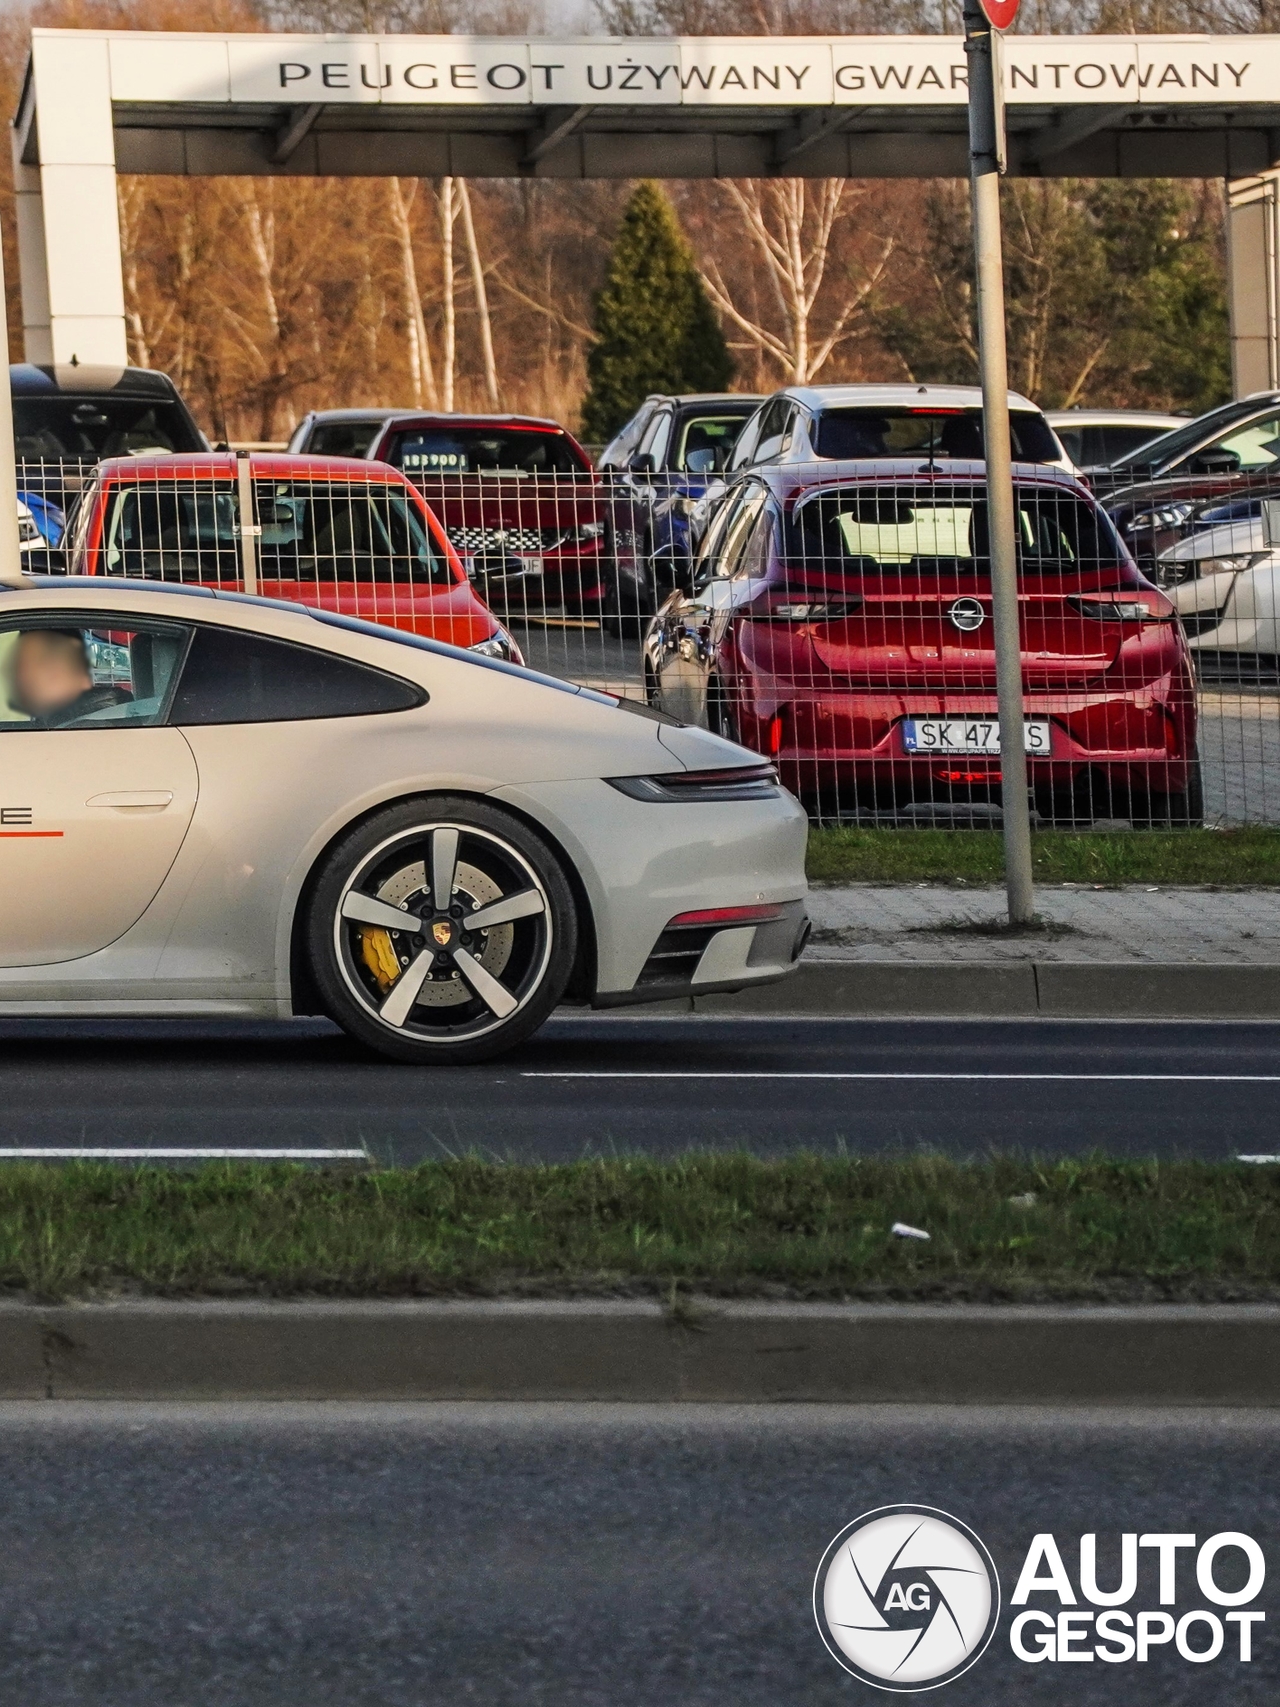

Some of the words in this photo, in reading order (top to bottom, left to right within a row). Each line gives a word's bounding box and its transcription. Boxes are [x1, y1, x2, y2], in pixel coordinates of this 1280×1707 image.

[279, 63, 565, 90] PEUGEOT
[587, 58, 811, 90] UŻYWANY
[835, 63, 1250, 90] GWARNTOWANY
[921, 723, 954, 747] SK
[965, 724, 1043, 748] 47S
